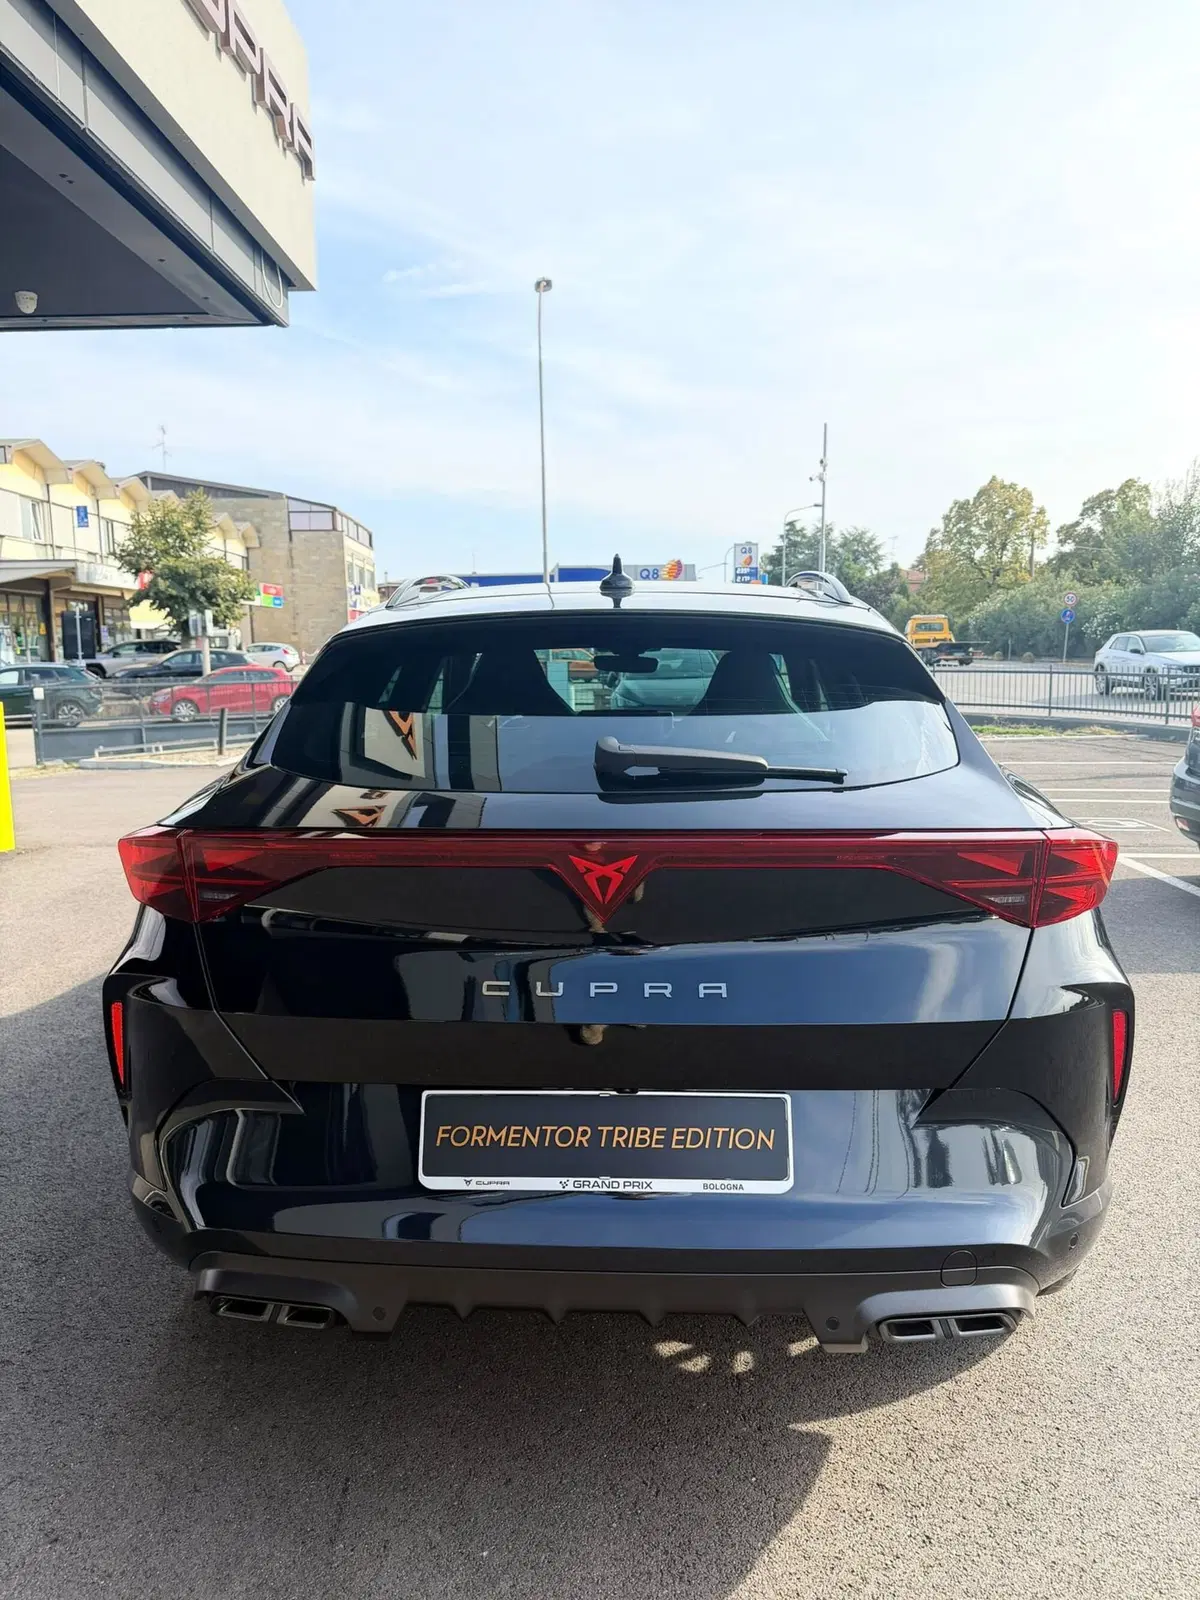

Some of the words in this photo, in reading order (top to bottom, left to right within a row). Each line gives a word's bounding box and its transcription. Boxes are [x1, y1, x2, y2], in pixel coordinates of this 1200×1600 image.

[640, 568, 659, 580] Q8
[481, 980, 728, 998] CUPRA
[436, 1125, 592, 1147] FORMENTOR
[597, 1126, 667, 1149] TRIBE
[671, 1127, 775, 1150] EDITION
[572, 1180, 620, 1190] GRAND
[622, 1180, 654, 1191] PRIX
[702, 1182, 745, 1192] BOLOGNA
